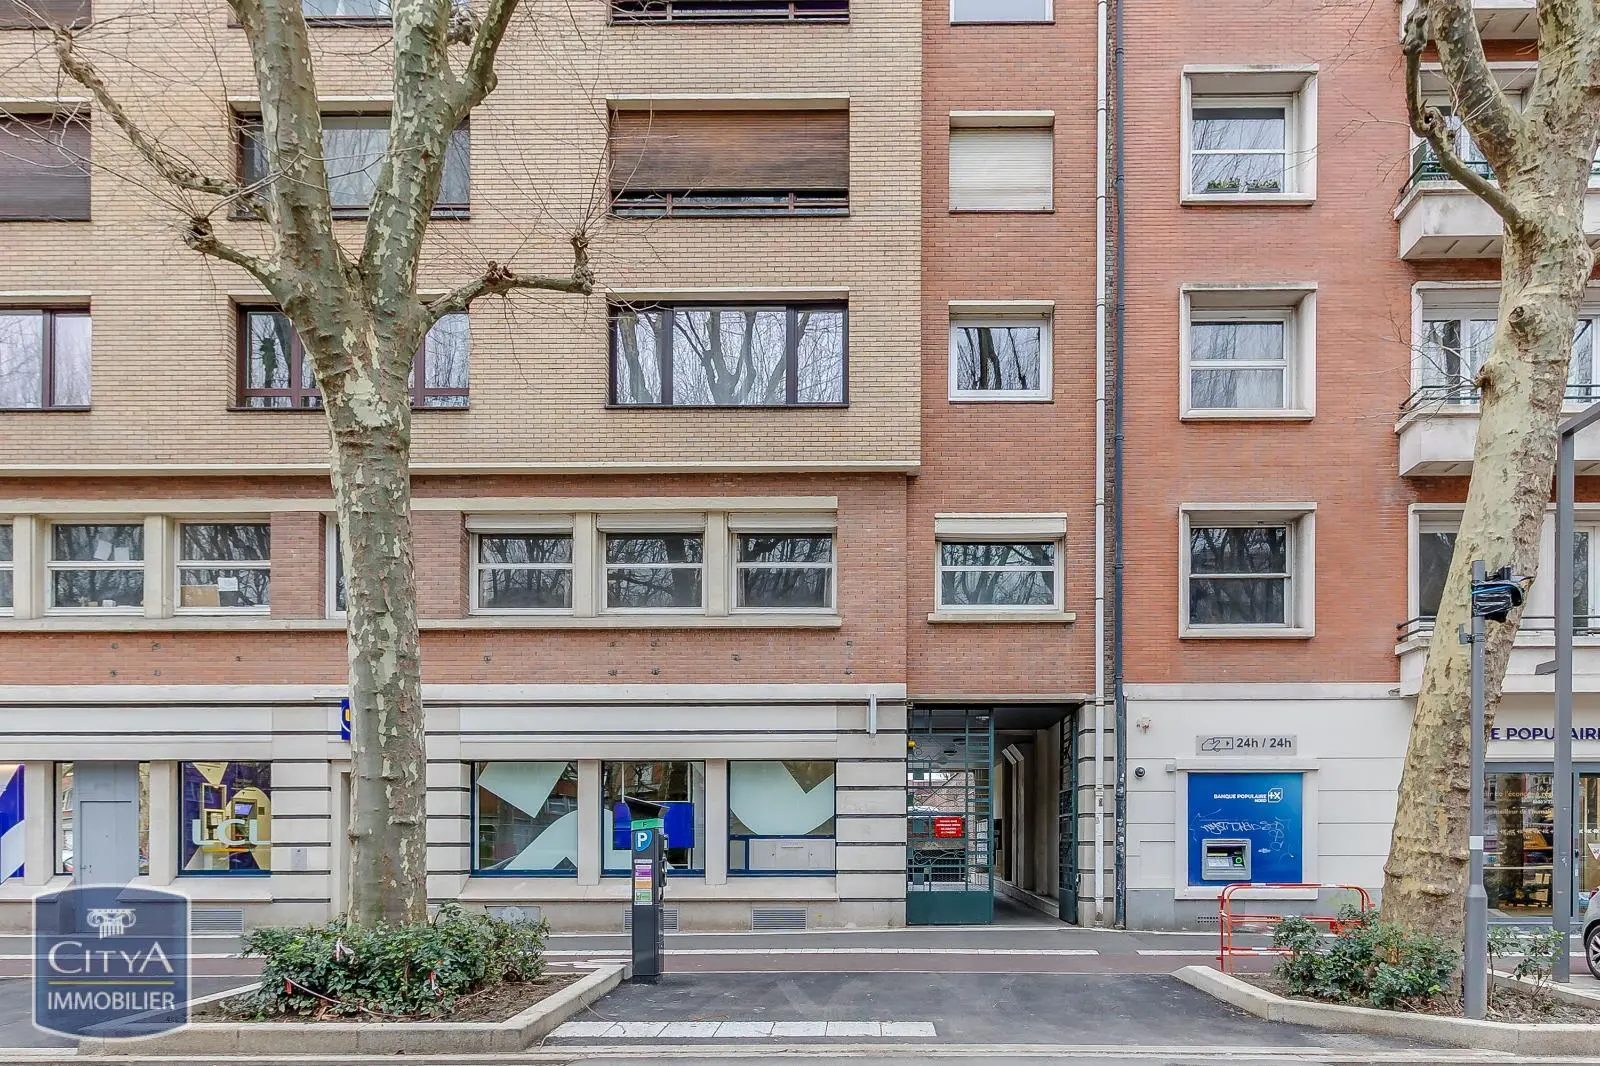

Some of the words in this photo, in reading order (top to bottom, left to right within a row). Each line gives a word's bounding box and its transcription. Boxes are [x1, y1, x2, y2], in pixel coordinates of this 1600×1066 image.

[1506, 727, 1600, 740] POPUAIR
[1236, 737, 1259, 748] 24h
[1269, 737, 1292, 748] 24h
[192, 818, 271, 845] LCL
[637, 832, 648, 848] P
